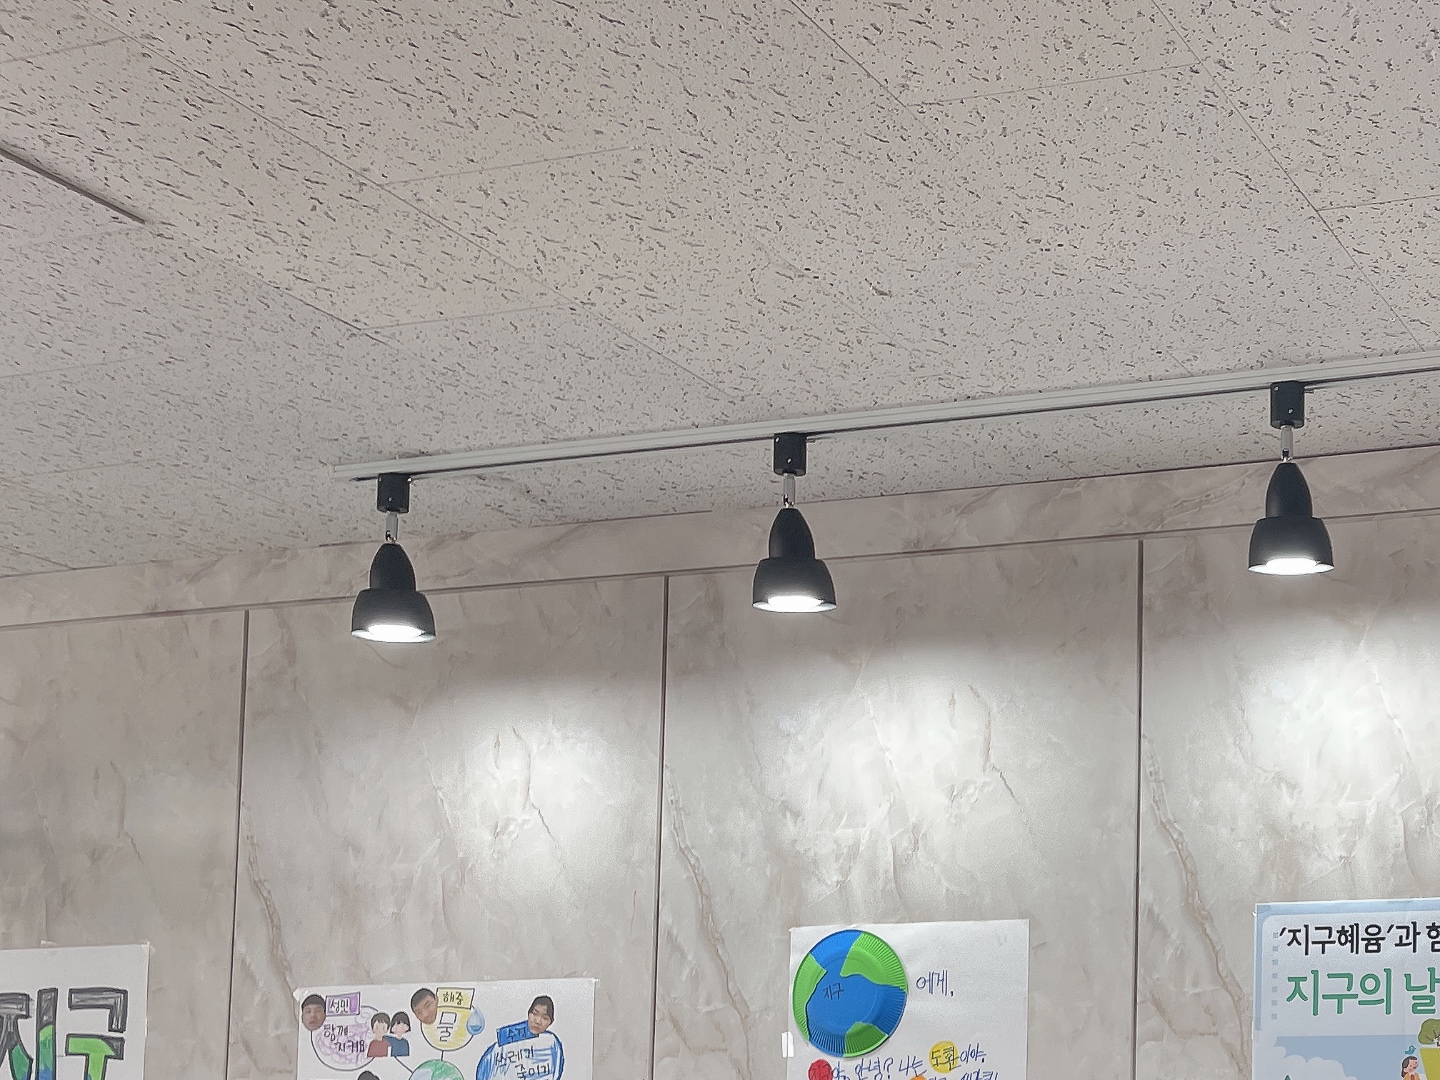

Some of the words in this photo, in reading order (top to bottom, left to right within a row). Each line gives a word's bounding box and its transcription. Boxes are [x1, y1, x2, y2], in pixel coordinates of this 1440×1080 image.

[822, 983, 844, 1000] 지구
[1286, 968, 1392, 1016] 지구의
[1404, 967, 1440, 1014] 날
[437, 1011, 457, 1042] 물
[899, 1055, 927, 1077] 나는
